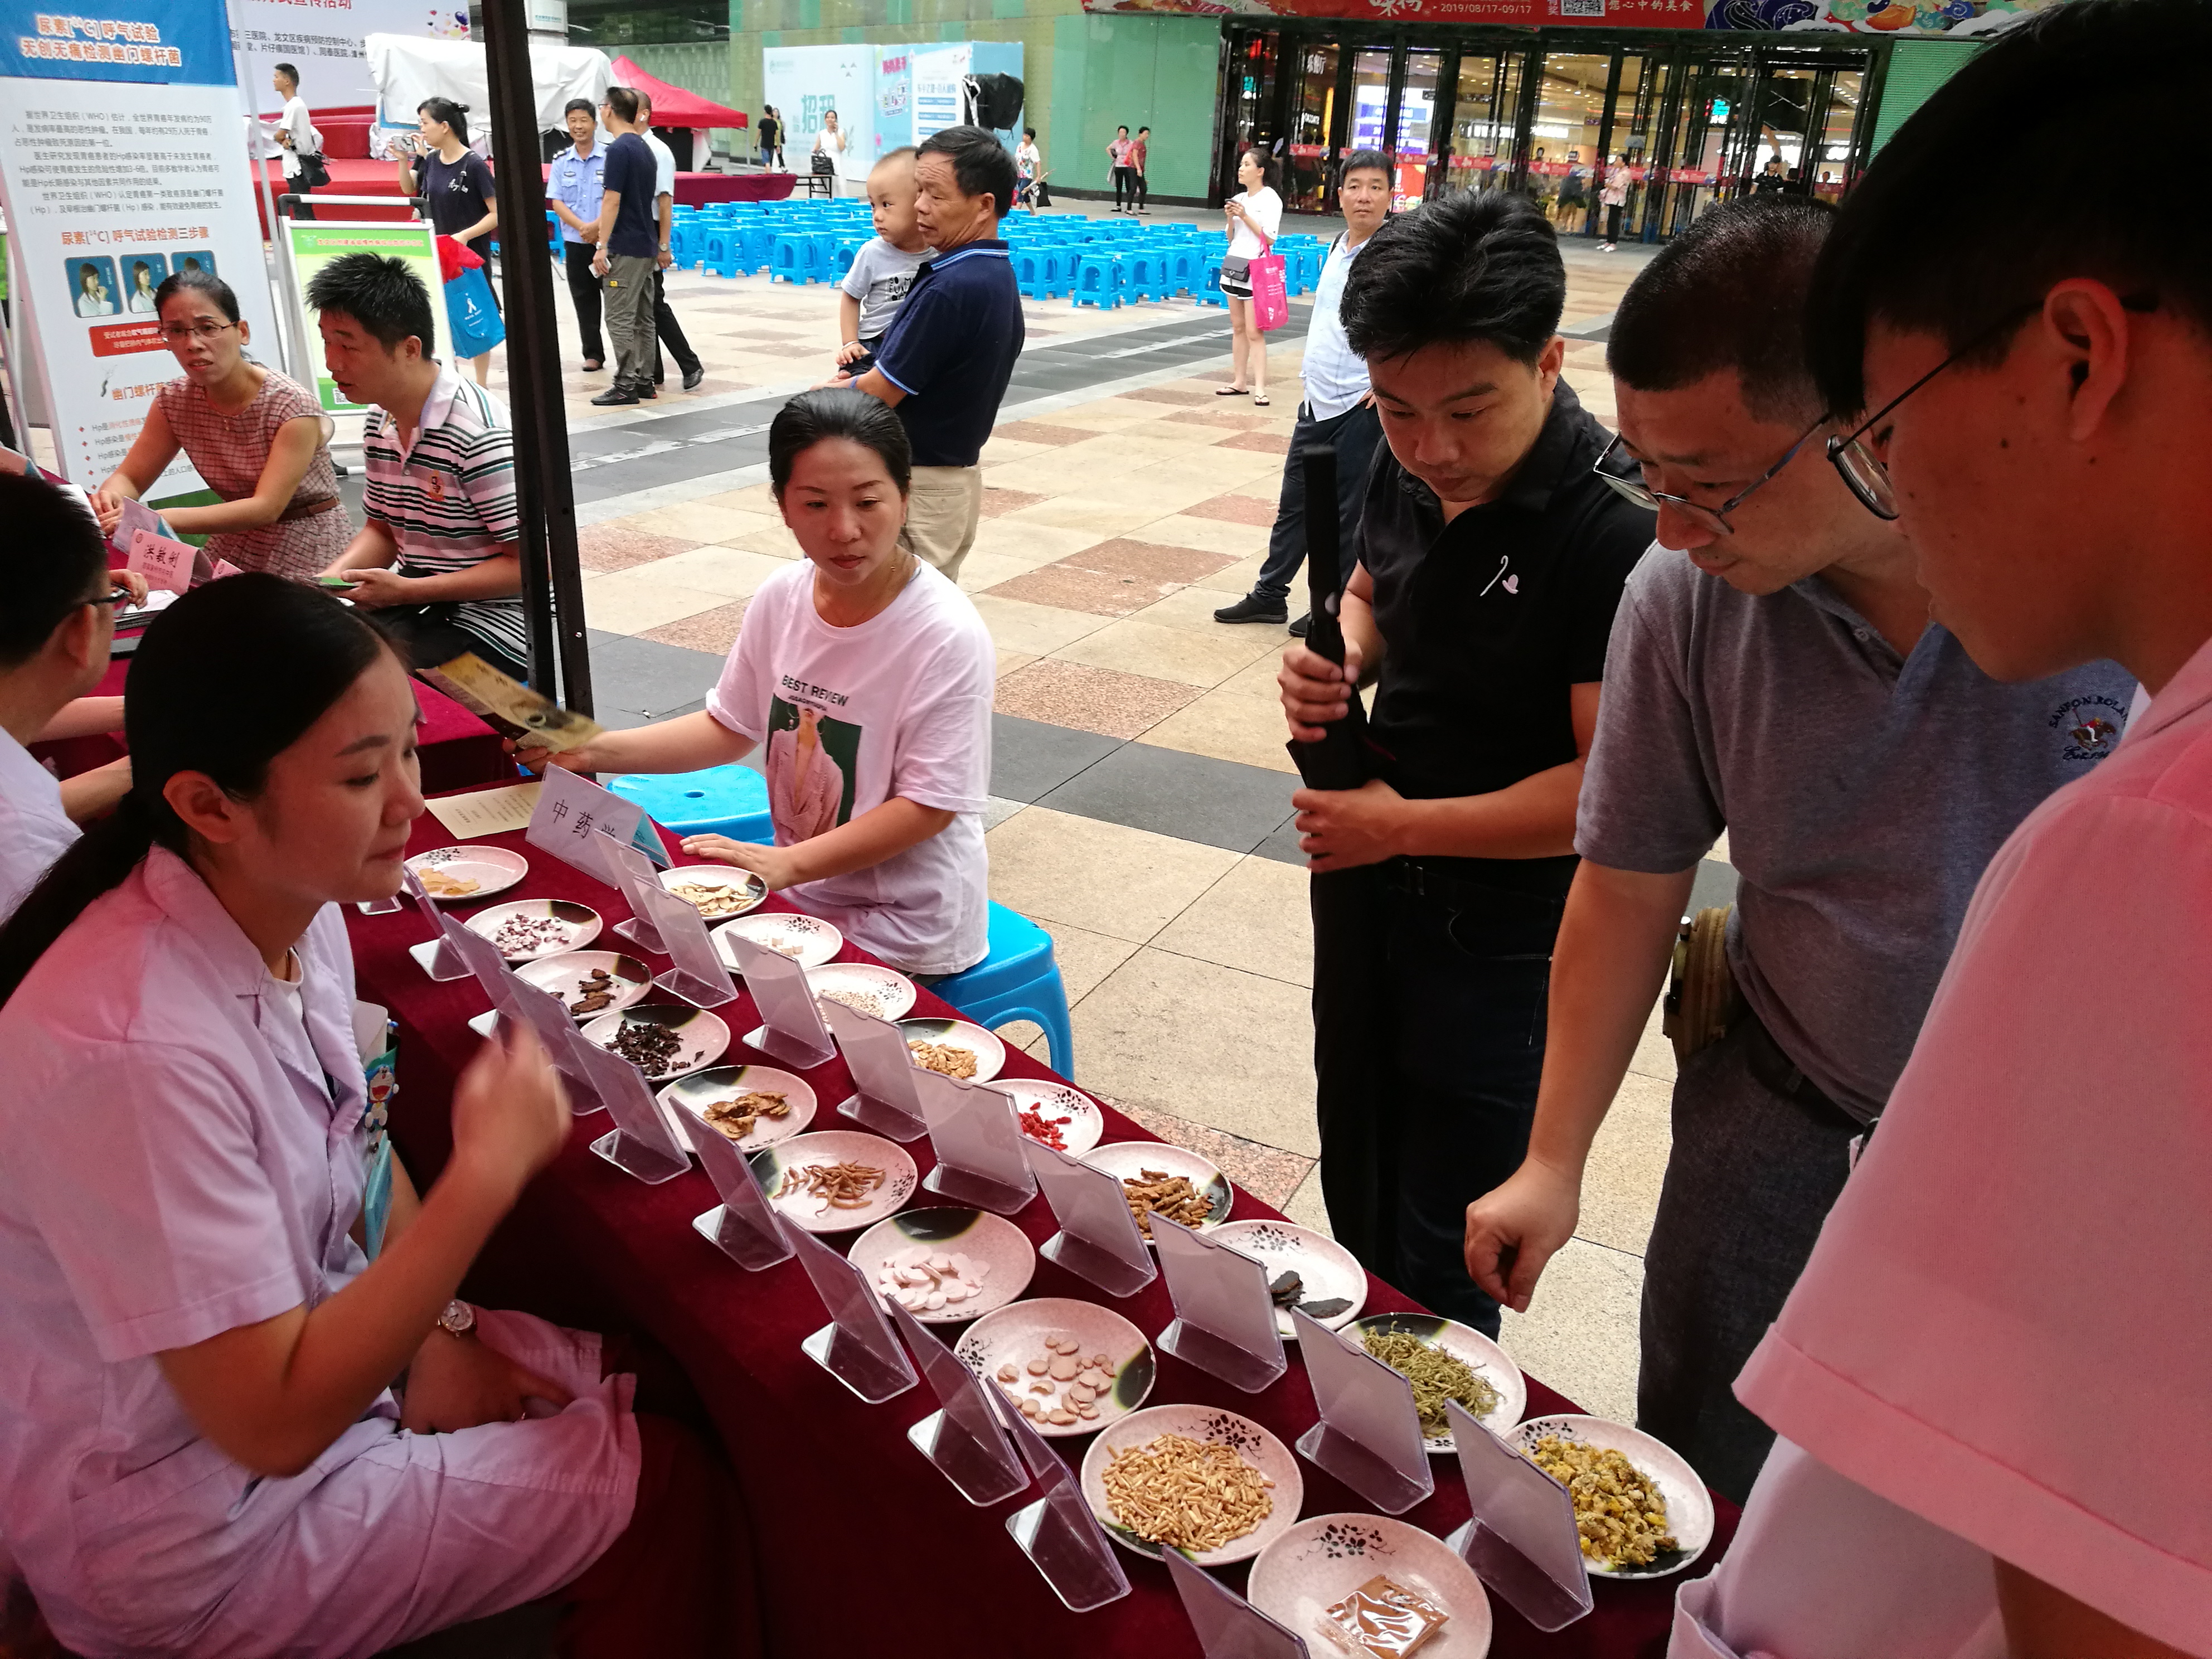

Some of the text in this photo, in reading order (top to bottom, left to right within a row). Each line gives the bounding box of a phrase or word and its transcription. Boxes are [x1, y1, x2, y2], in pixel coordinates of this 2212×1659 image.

[1441, 4, 1531, 14] 2019/08/17-09/17
[782, 675, 808, 693] BEST
[811, 685, 850, 707] REVIEW
